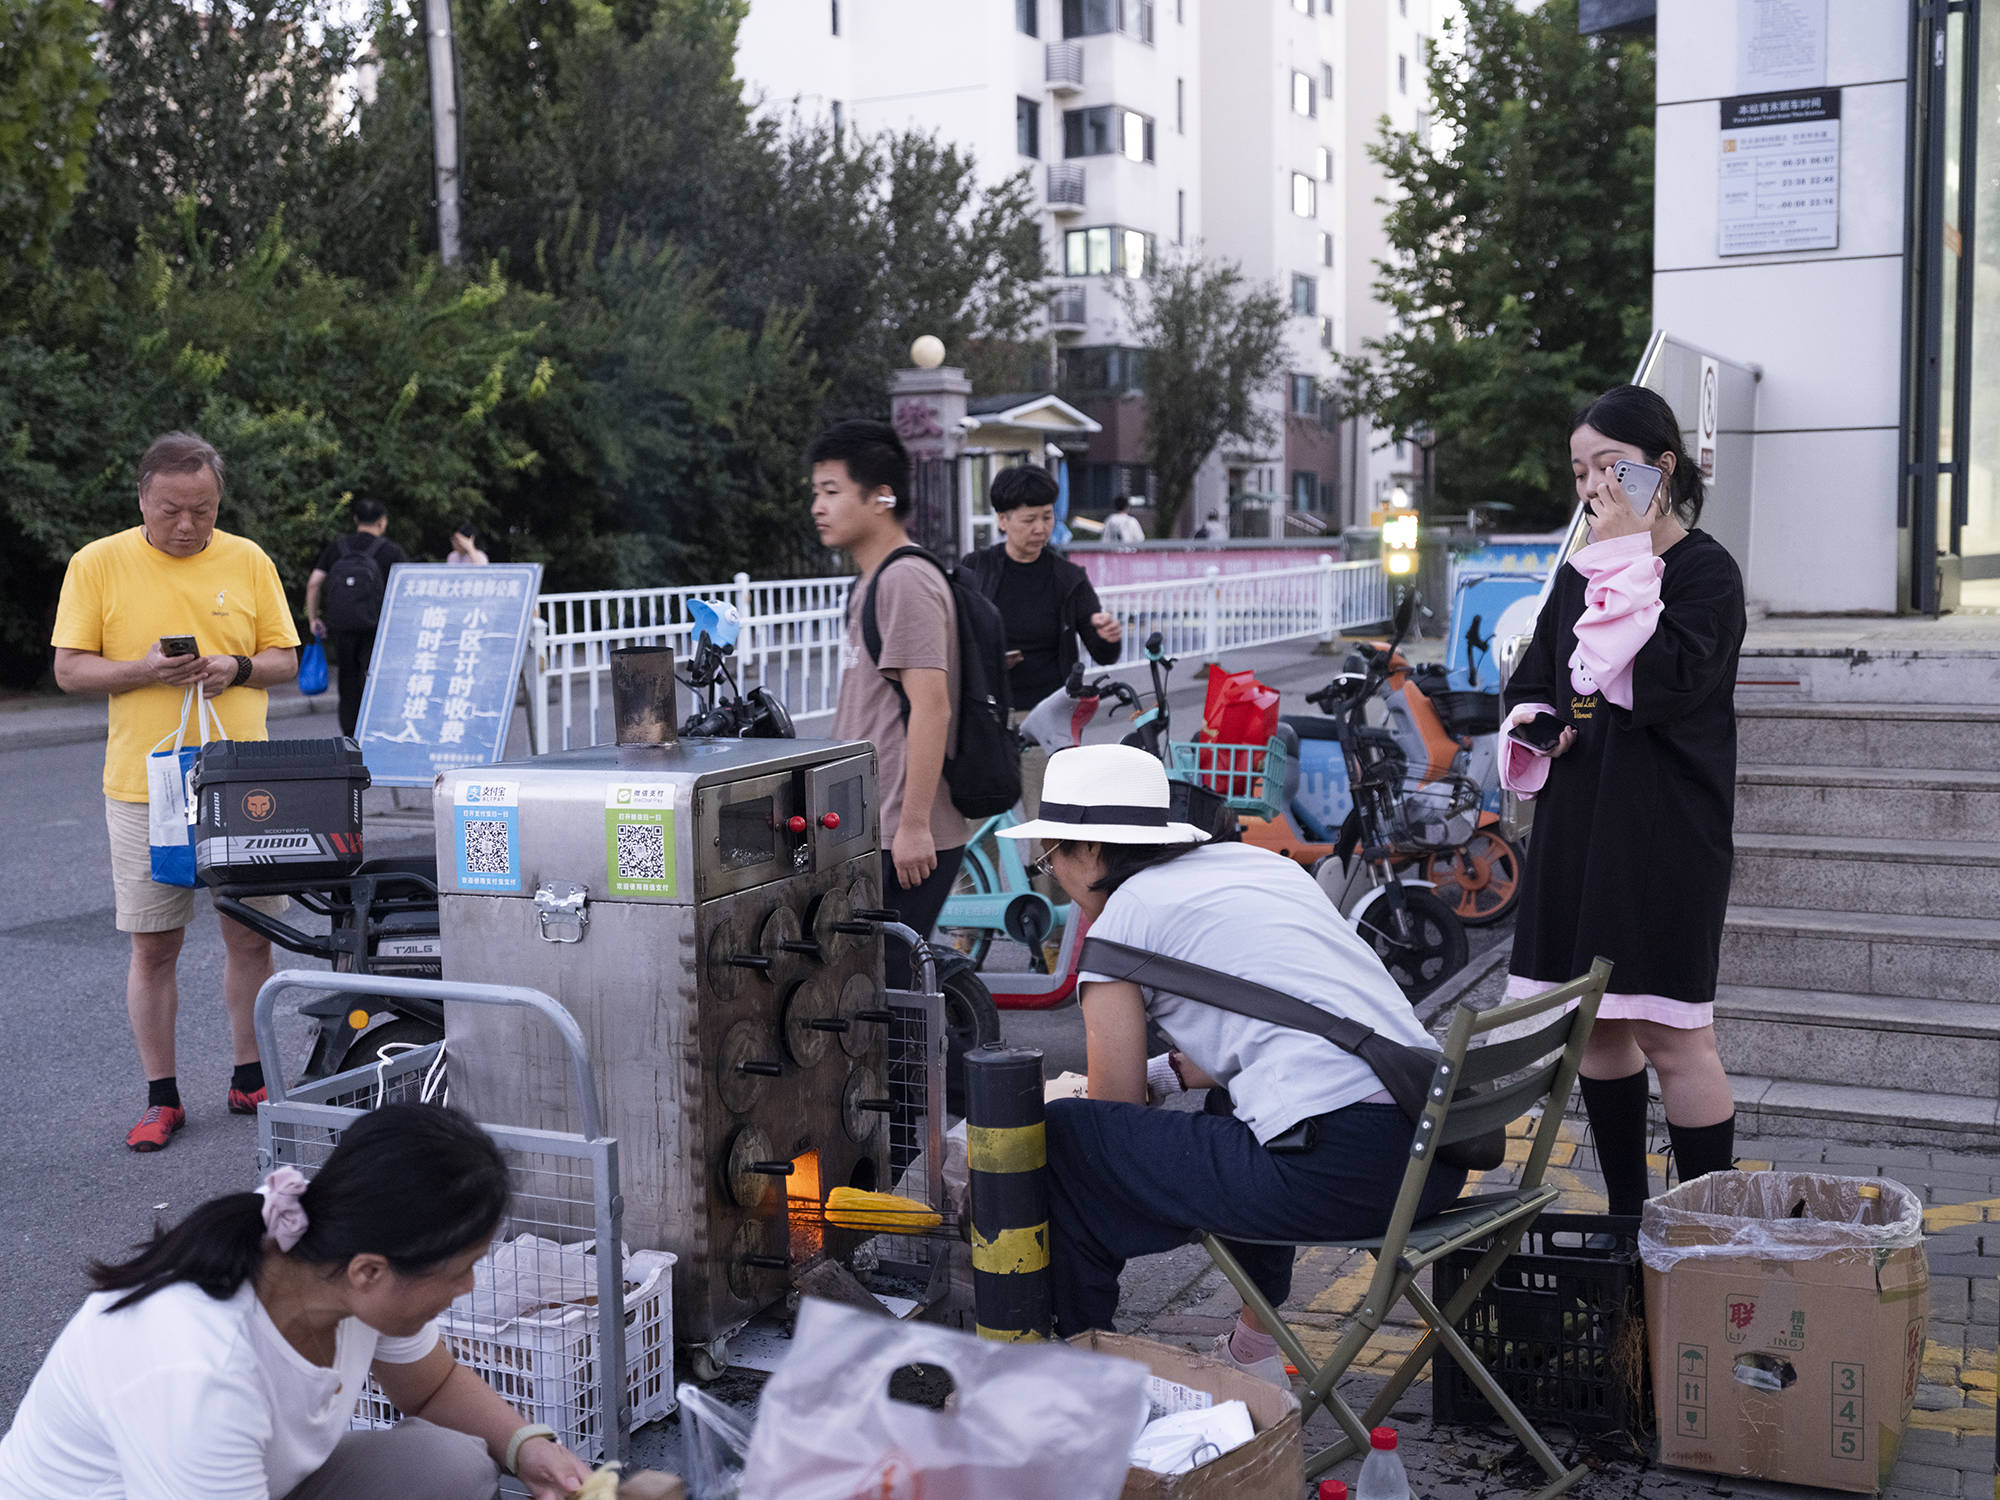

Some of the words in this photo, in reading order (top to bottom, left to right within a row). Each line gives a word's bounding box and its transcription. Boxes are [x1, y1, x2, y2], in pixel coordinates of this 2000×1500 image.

[401, 606, 448, 742] 临时车辆进入
[439, 607, 488, 744] 小区计时收费
[482, 786, 506, 797] 支付宝
[633, 789, 664, 798] 微信支付
[213, 792, 221, 828] ZUBOO
[244, 836, 308, 849] ZUBOO
[393, 944, 433, 955] TAILG
[1840, 1368, 1856, 1391] 3
[1839, 1401, 1856, 1423] 4
[1840, 1431, 1856, 1454] 5
